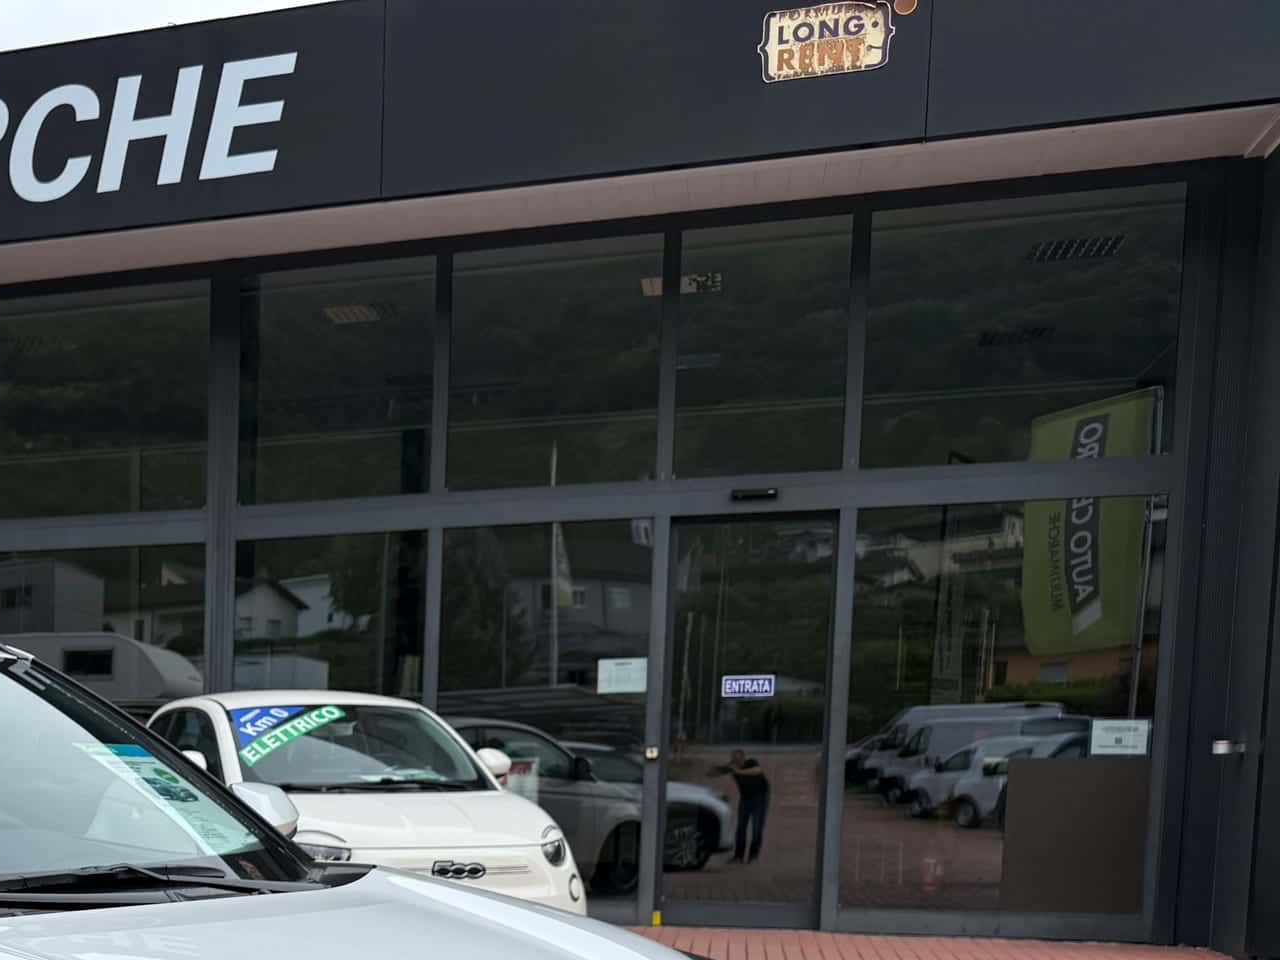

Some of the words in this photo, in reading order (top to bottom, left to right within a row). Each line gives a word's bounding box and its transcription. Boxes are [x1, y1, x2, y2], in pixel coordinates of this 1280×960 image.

[777, 15, 865, 45] LONG
[776, 38, 864, 72] RENT
[726, 680, 770, 693] ENTRATA
[239, 717, 277, 736] Km
[269, 708, 288, 718] 0
[241, 706, 339, 763] ELETTRICO
